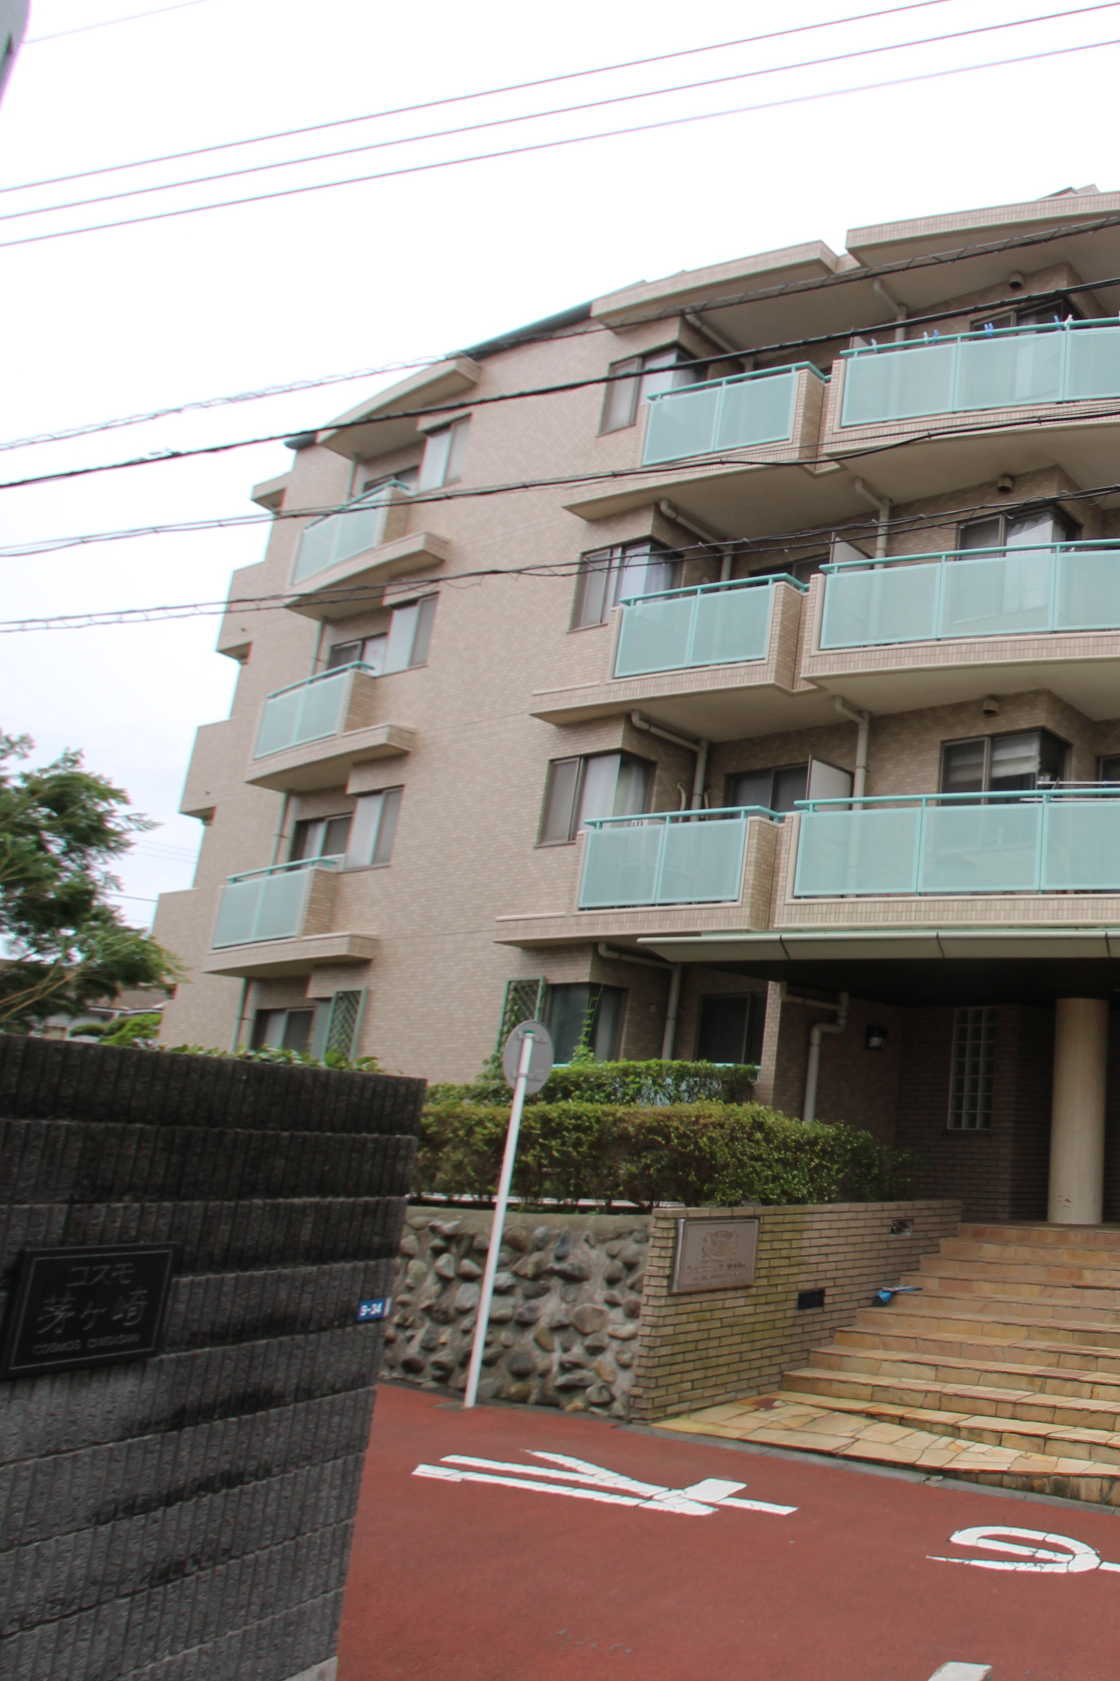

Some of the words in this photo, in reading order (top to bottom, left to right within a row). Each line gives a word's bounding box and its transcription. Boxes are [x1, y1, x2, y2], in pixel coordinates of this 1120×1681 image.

[67, 1263, 136, 1287] コスモ
[359, 1302, 383, 1317] 9-34
